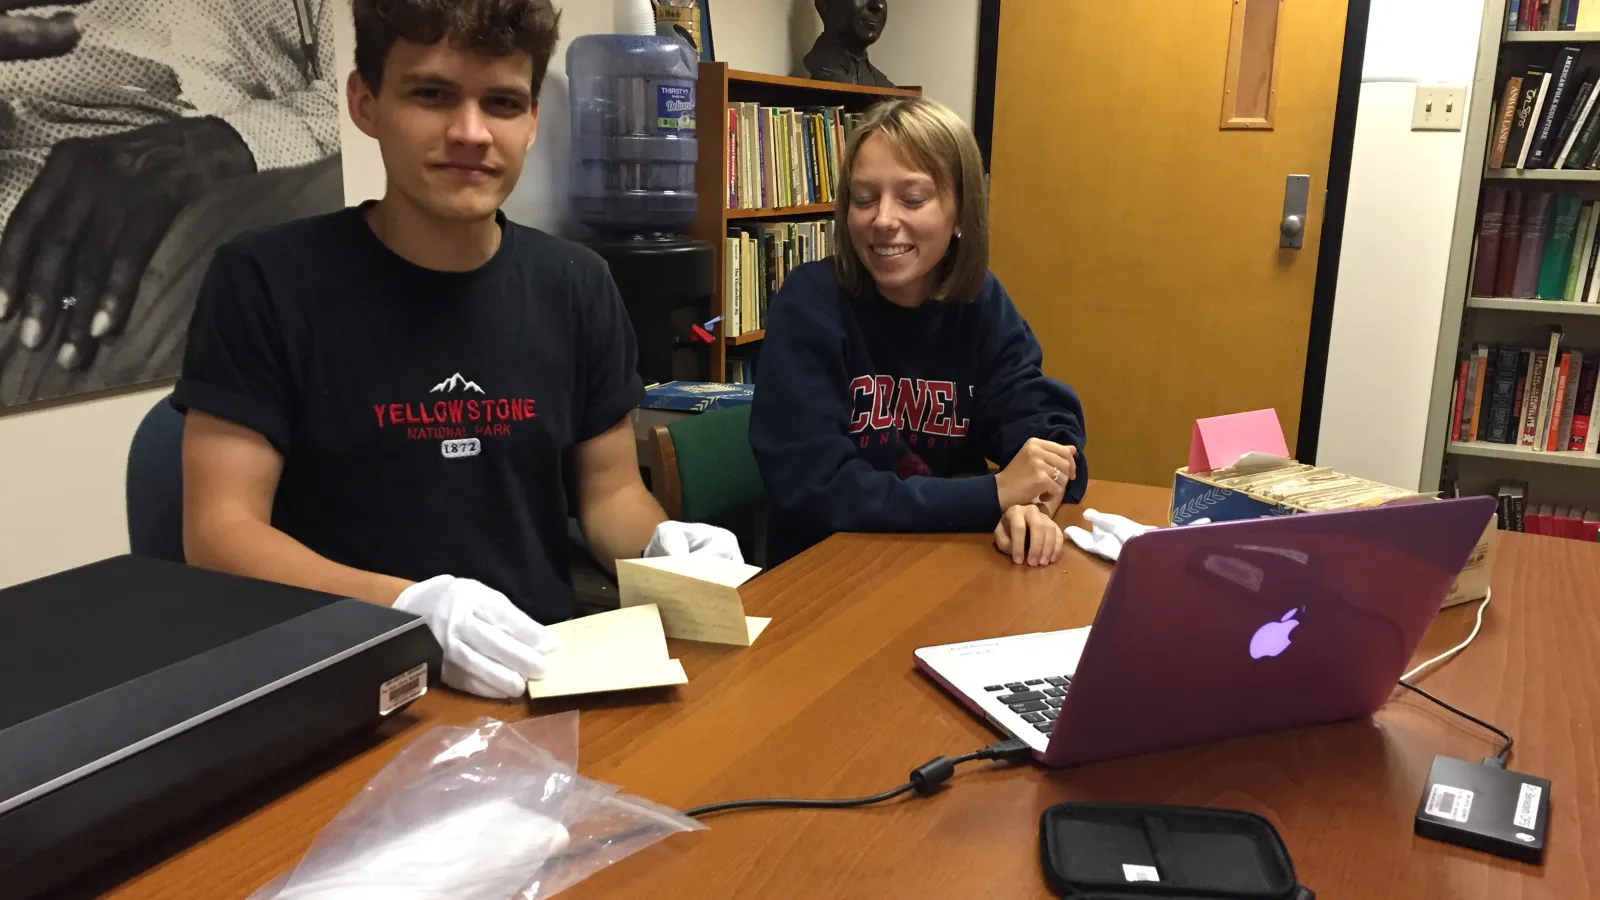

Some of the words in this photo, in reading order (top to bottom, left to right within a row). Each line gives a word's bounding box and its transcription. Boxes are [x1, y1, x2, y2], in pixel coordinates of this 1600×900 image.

[1558, 56, 1573, 87] AMERICAN
[1505, 86, 1518, 119] ANIMAL
[1551, 87, 1563, 104] FOLK
[1517, 103, 1532, 129] Signs
[1540, 103, 1558, 140] SCULPTURE
[1498, 119, 1511, 144] LAND
[373, 398, 537, 428] YELLOWSTONE
[407, 426, 468, 440] NATIONAL
[475, 423, 511, 437] PARK
[444, 442, 477, 454] 1872
